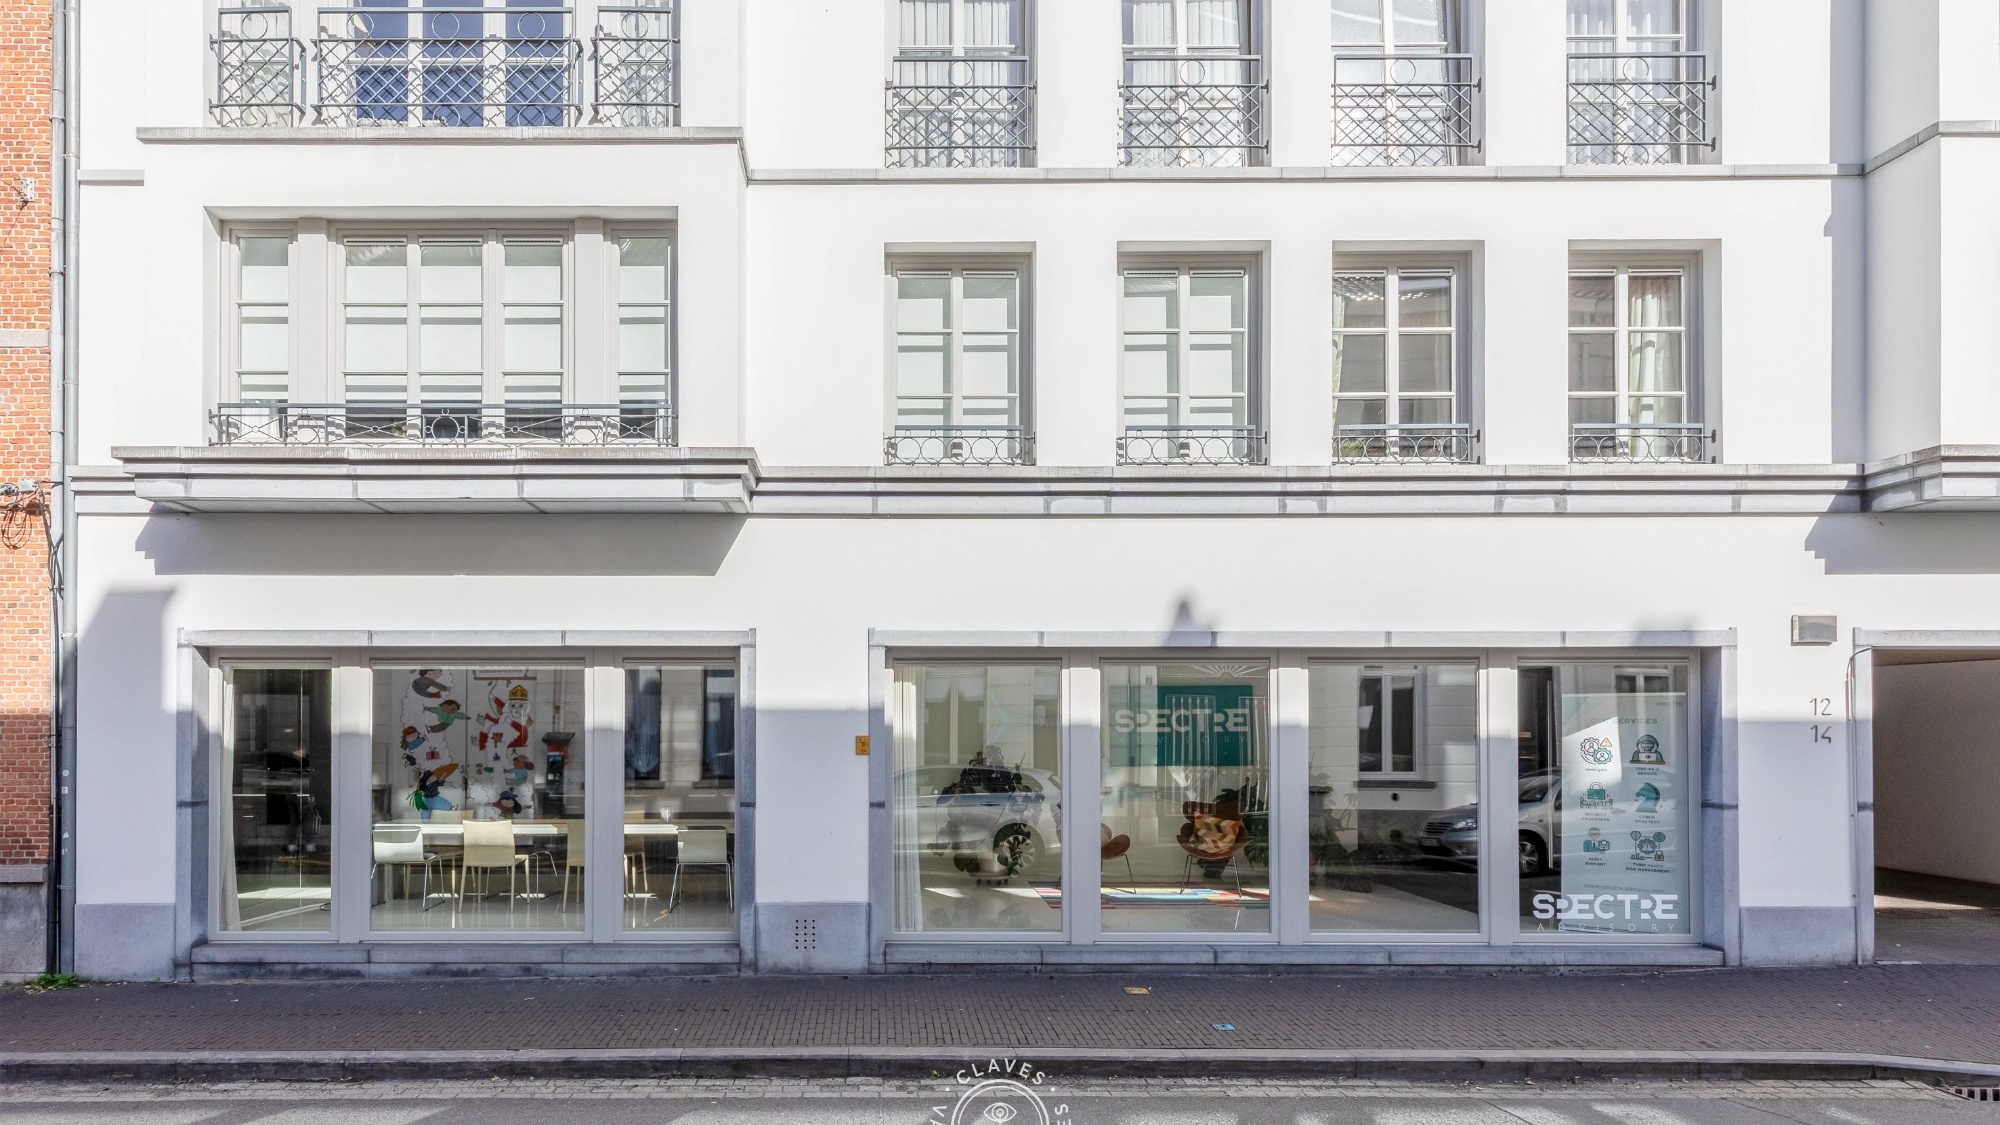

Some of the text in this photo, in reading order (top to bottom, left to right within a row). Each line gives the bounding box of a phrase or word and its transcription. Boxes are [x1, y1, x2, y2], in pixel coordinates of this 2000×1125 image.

[1809, 697, 1832, 716] 12
[1114, 708, 1249, 733] SPECTRE
[1119, 735, 1245, 744] ADVSORY
[1810, 724, 1832, 744] 14
[1533, 893, 1679, 920] SPECTRE
[1537, 922, 1676, 932] ADVISORY
